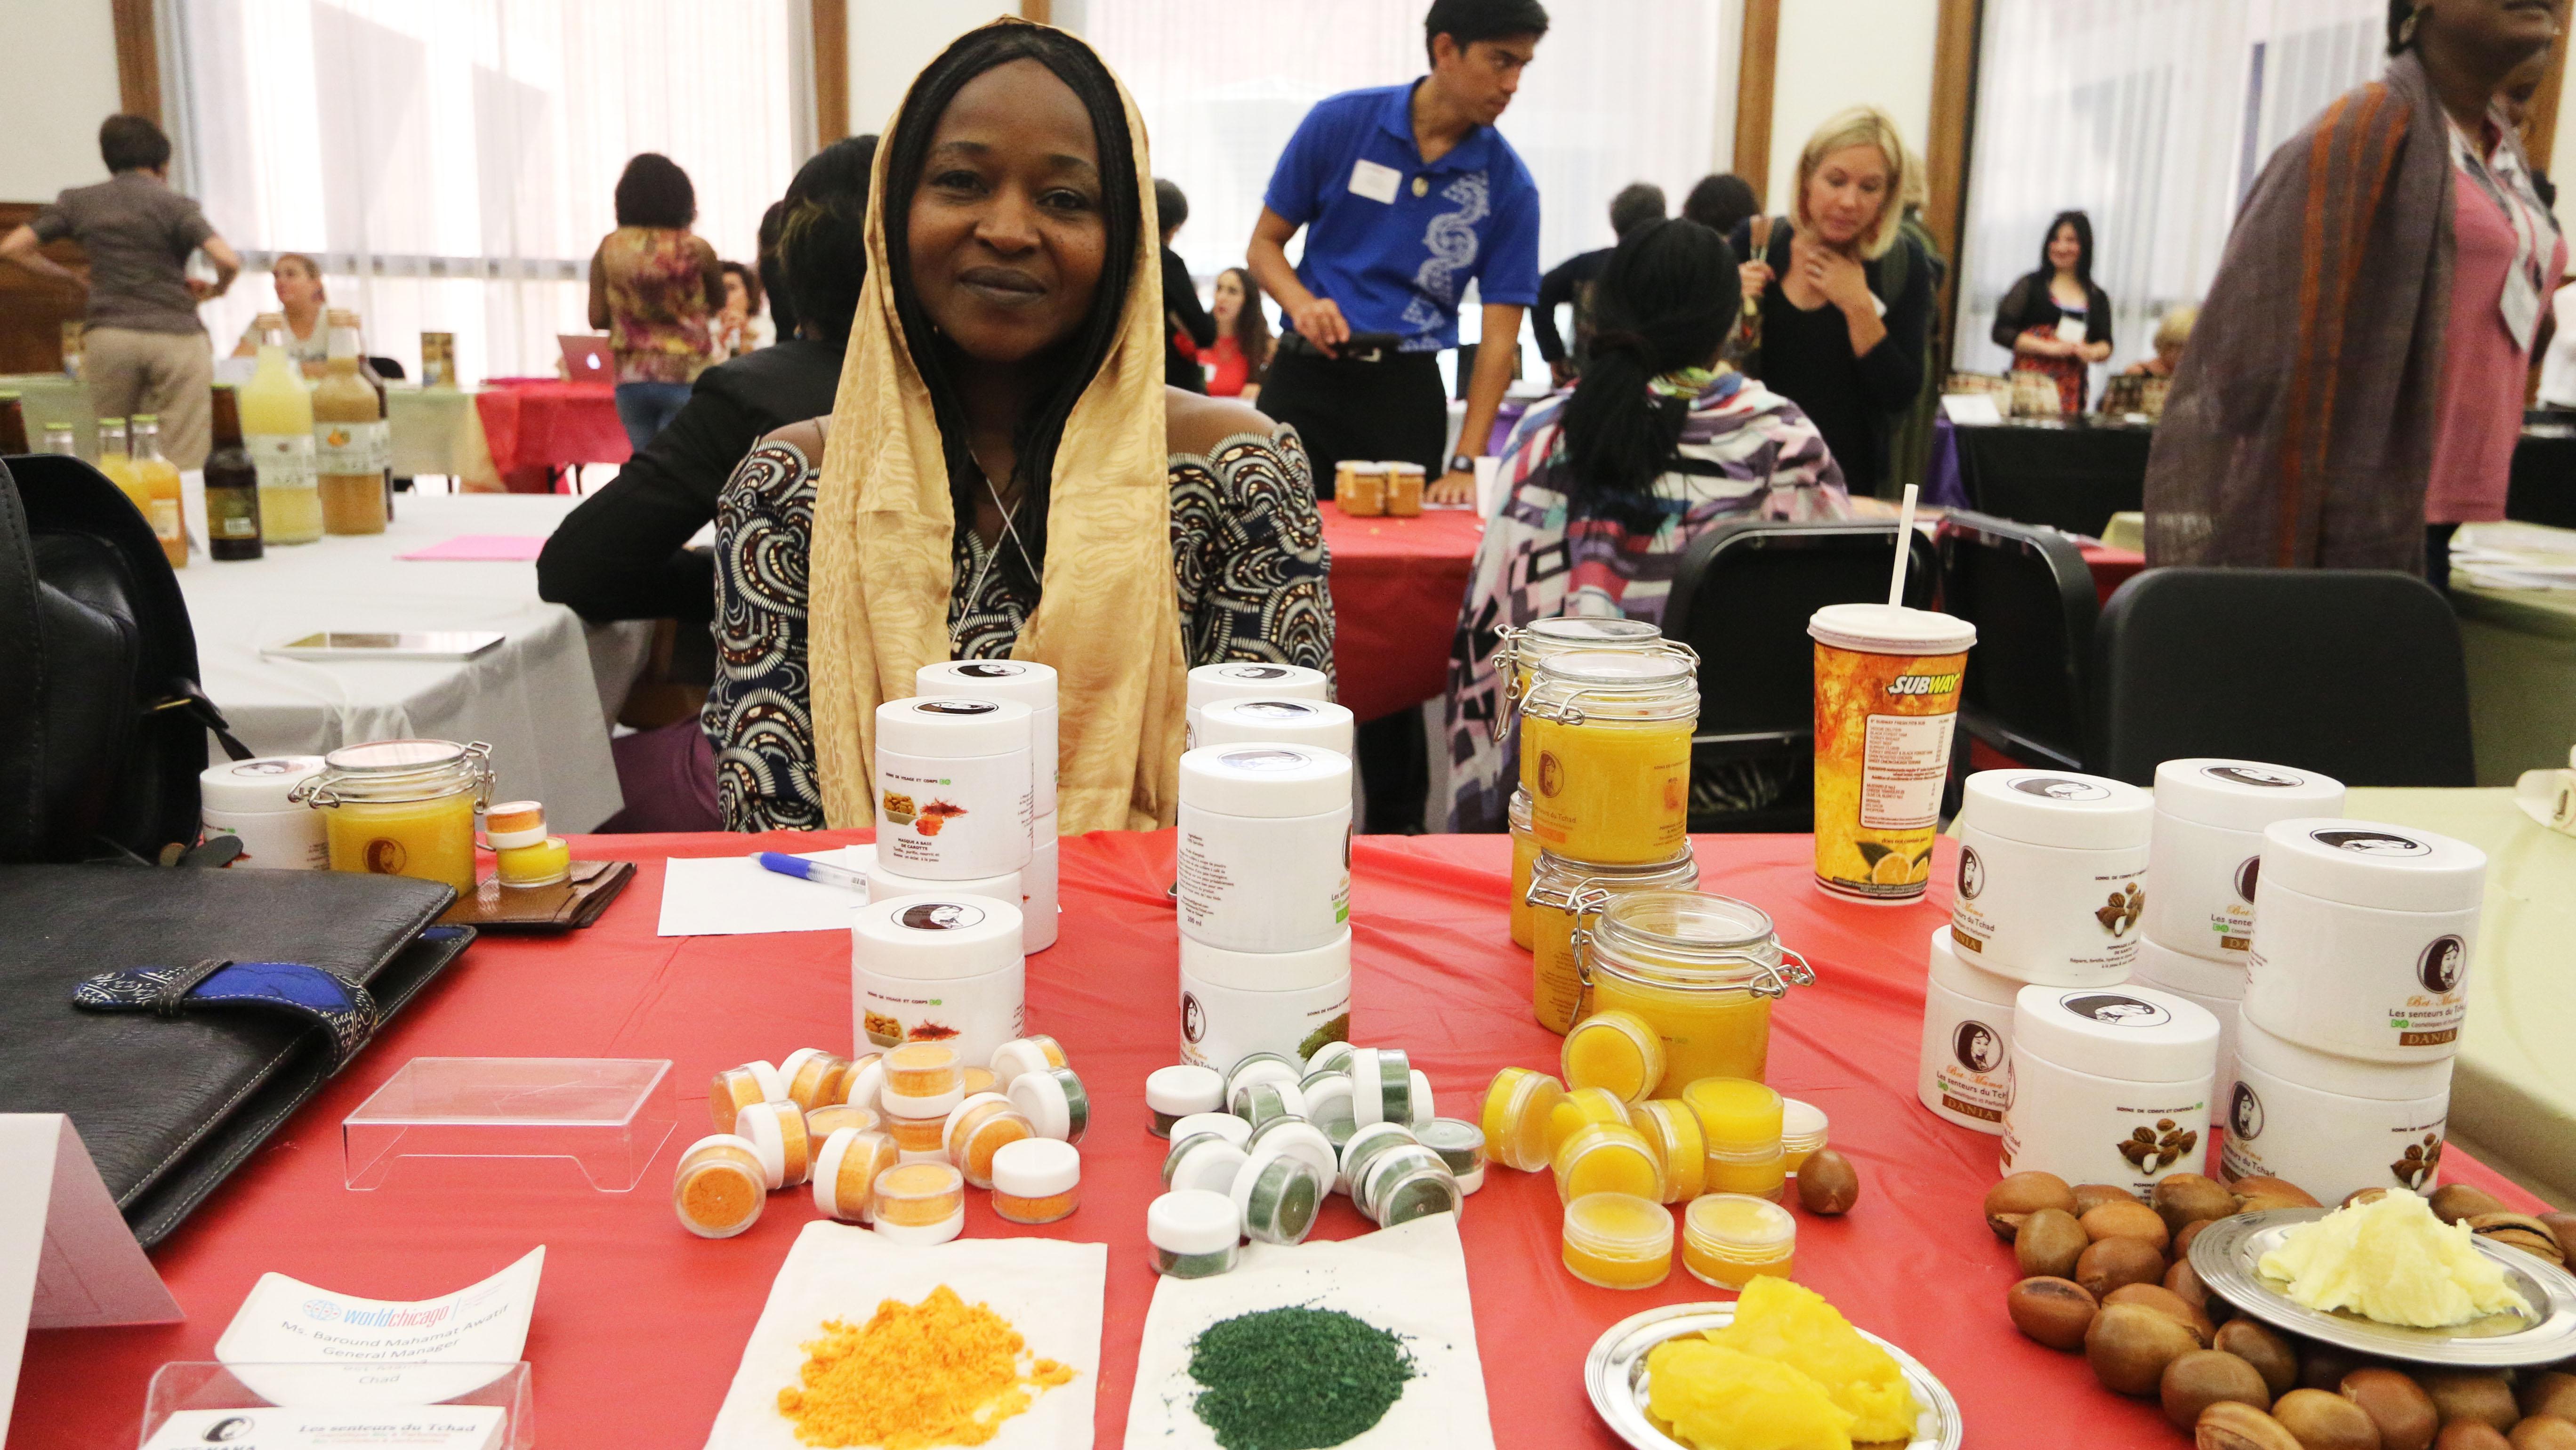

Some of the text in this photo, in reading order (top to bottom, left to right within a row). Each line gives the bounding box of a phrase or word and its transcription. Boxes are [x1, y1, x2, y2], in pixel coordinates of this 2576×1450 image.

[1887, 672, 1961, 696] SUBWAY
[1558, 814, 1576, 823] Tchad
[1967, 916, 1974, 924] du
[1975, 918, 1995, 931] Tchad
[2211, 914, 2252, 926] Les sente
[2408, 1031, 2452, 1044] DANIA
[1193, 1058, 1218, 1072] du Tchad
[1937, 1070, 2006, 1100] Les senteurs du Tch
[1948, 1098, 1994, 1120] DANIA
[2242, 1158, 2251, 1166] du
[2252, 1161, 2275, 1177] Tchad
[282, 1304, 509, 1346] Ms. Baround Mahamat Awatif
[344, 1305, 450, 1328] worldchicago
[322, 1339, 459, 1358] General Manager
[359, 1374, 400, 1384] Chad
[428, 1423, 476, 1432] Tchad
